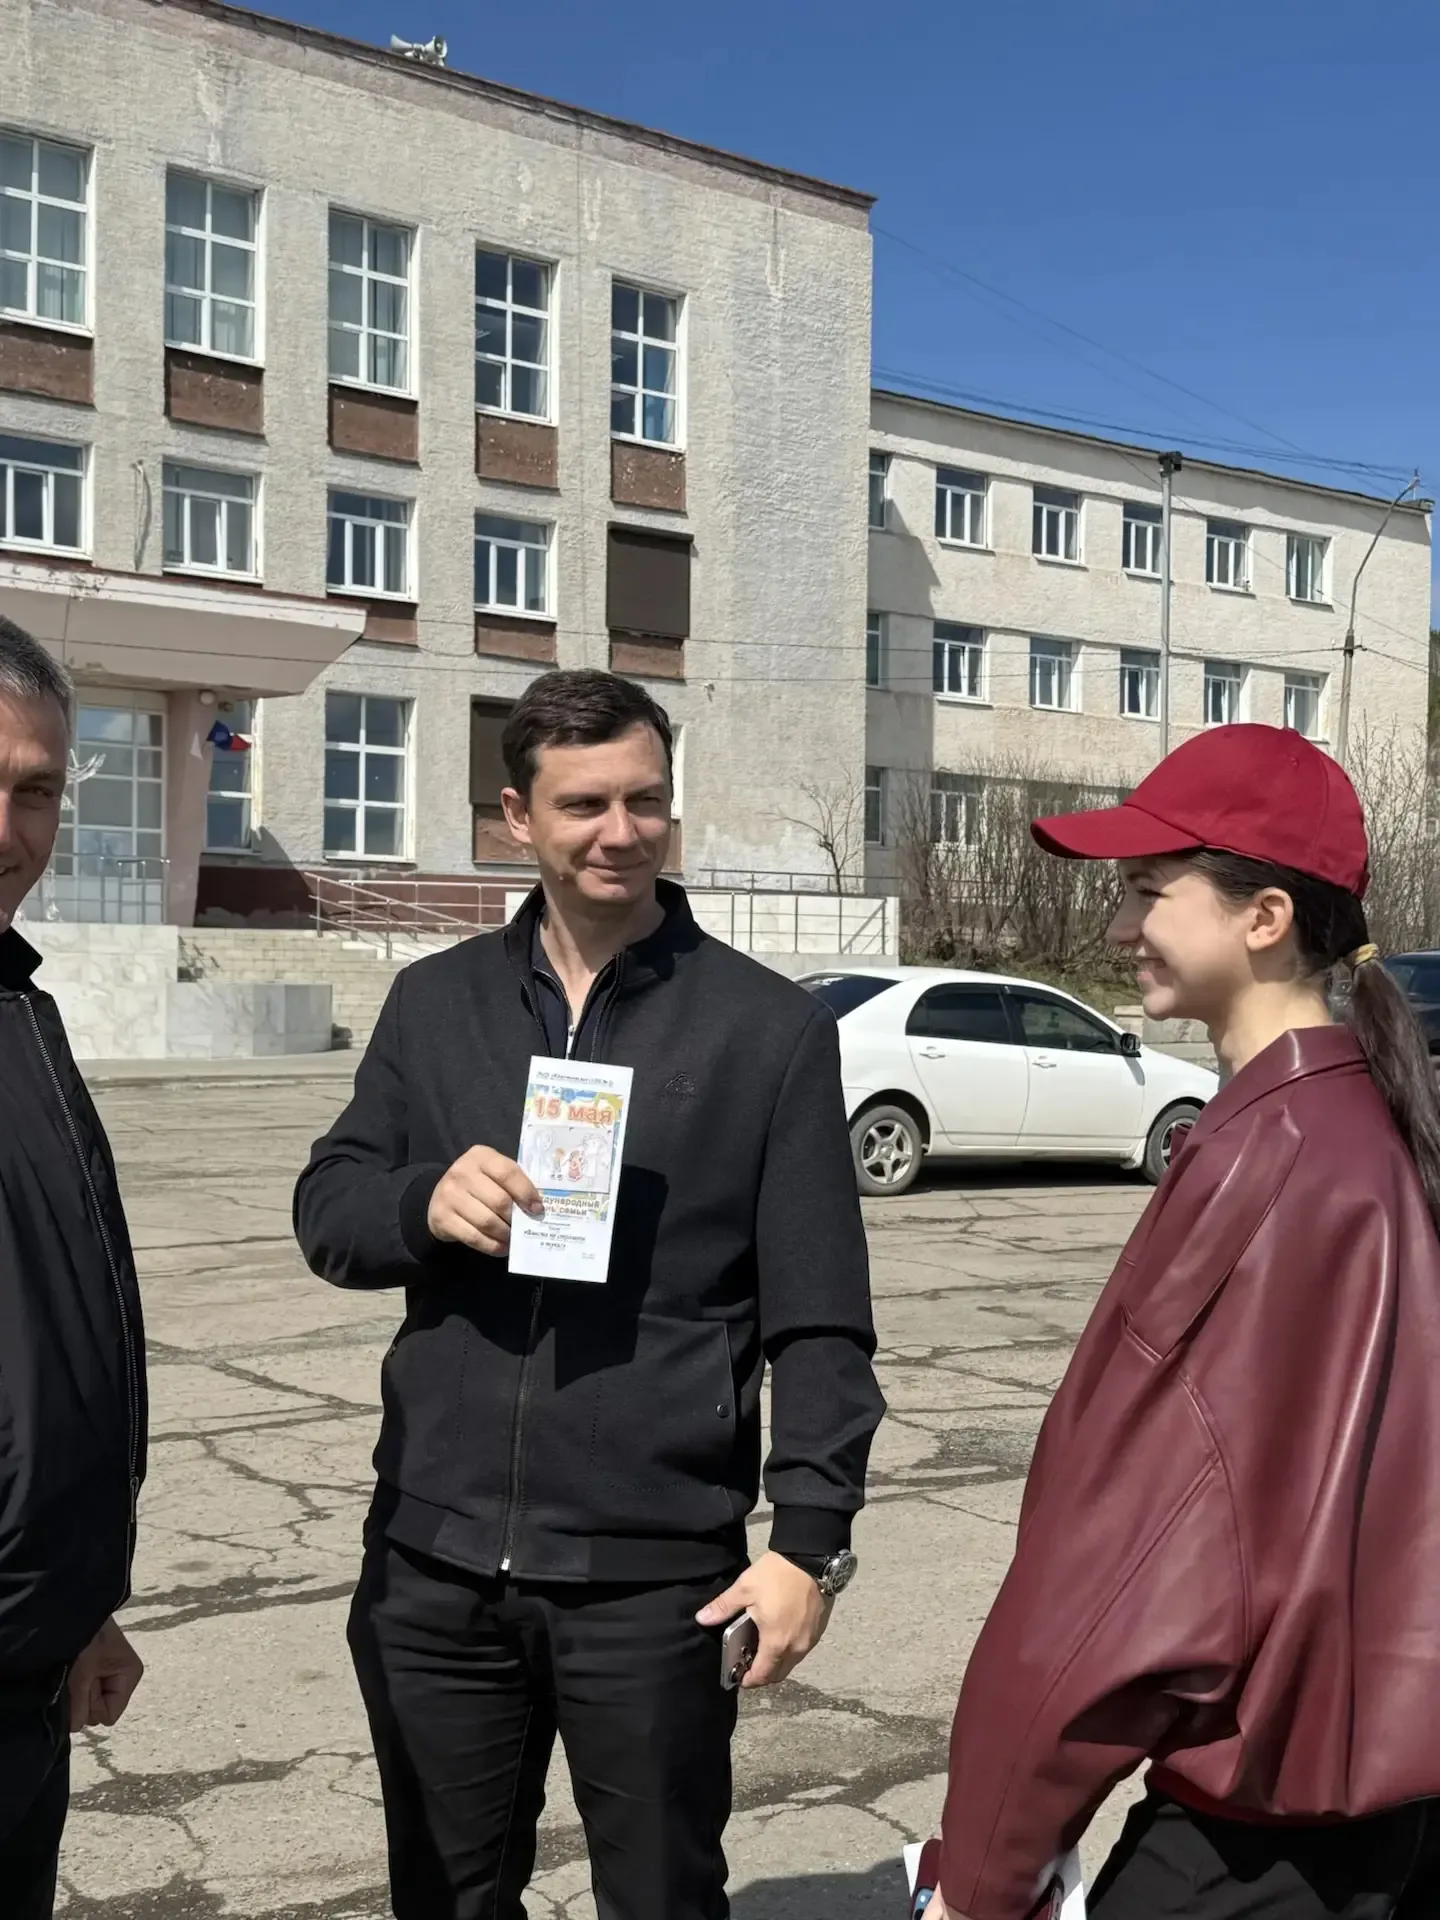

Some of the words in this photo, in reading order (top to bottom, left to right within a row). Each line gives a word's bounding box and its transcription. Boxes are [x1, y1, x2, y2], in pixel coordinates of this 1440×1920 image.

[535, 1096, 561, 1118] 15
[567, 1104, 613, 1125] мая
[543, 1197, 600, 1209] дународный
